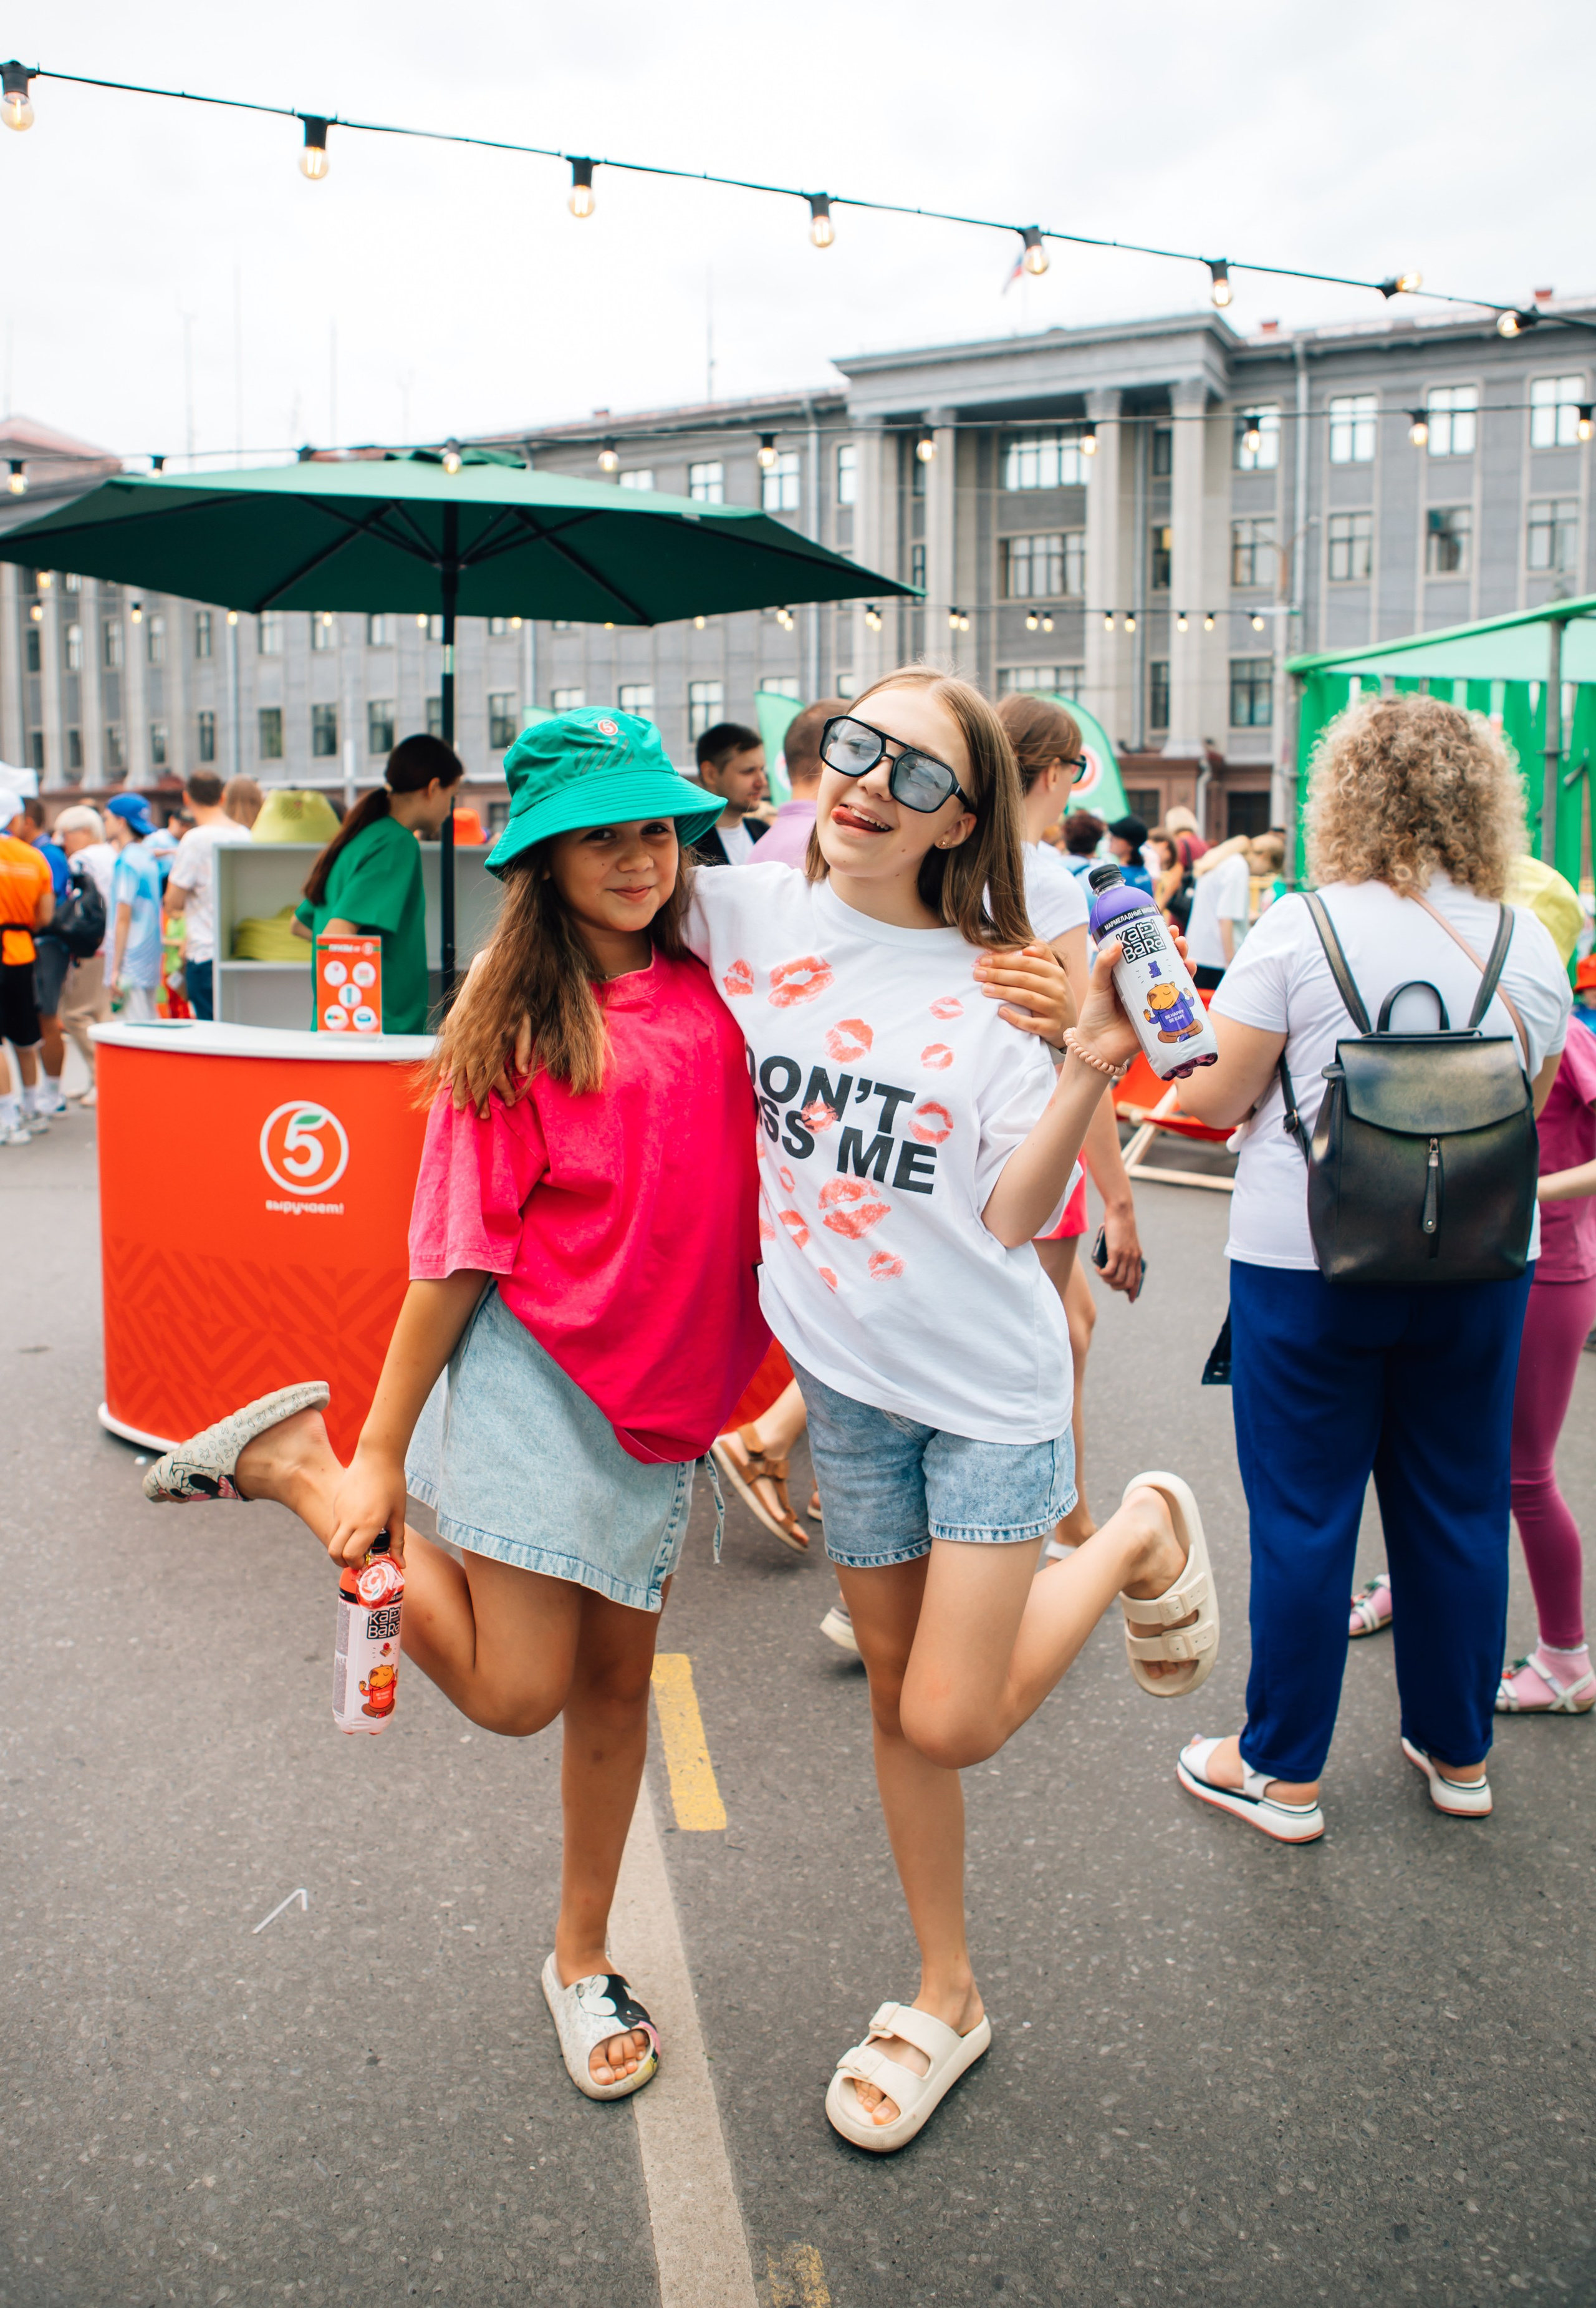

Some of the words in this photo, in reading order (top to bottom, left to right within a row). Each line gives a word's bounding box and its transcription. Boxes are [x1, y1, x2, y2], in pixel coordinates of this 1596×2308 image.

[1104, 909, 1143, 930] МАРМЕЛАДНЫЕ
[283, 1108, 327, 1177] 5
[759, 1096, 814, 1159] SS
[837, 1126, 937, 1194] ME
[266, 1199, 344, 1215] выручает!
